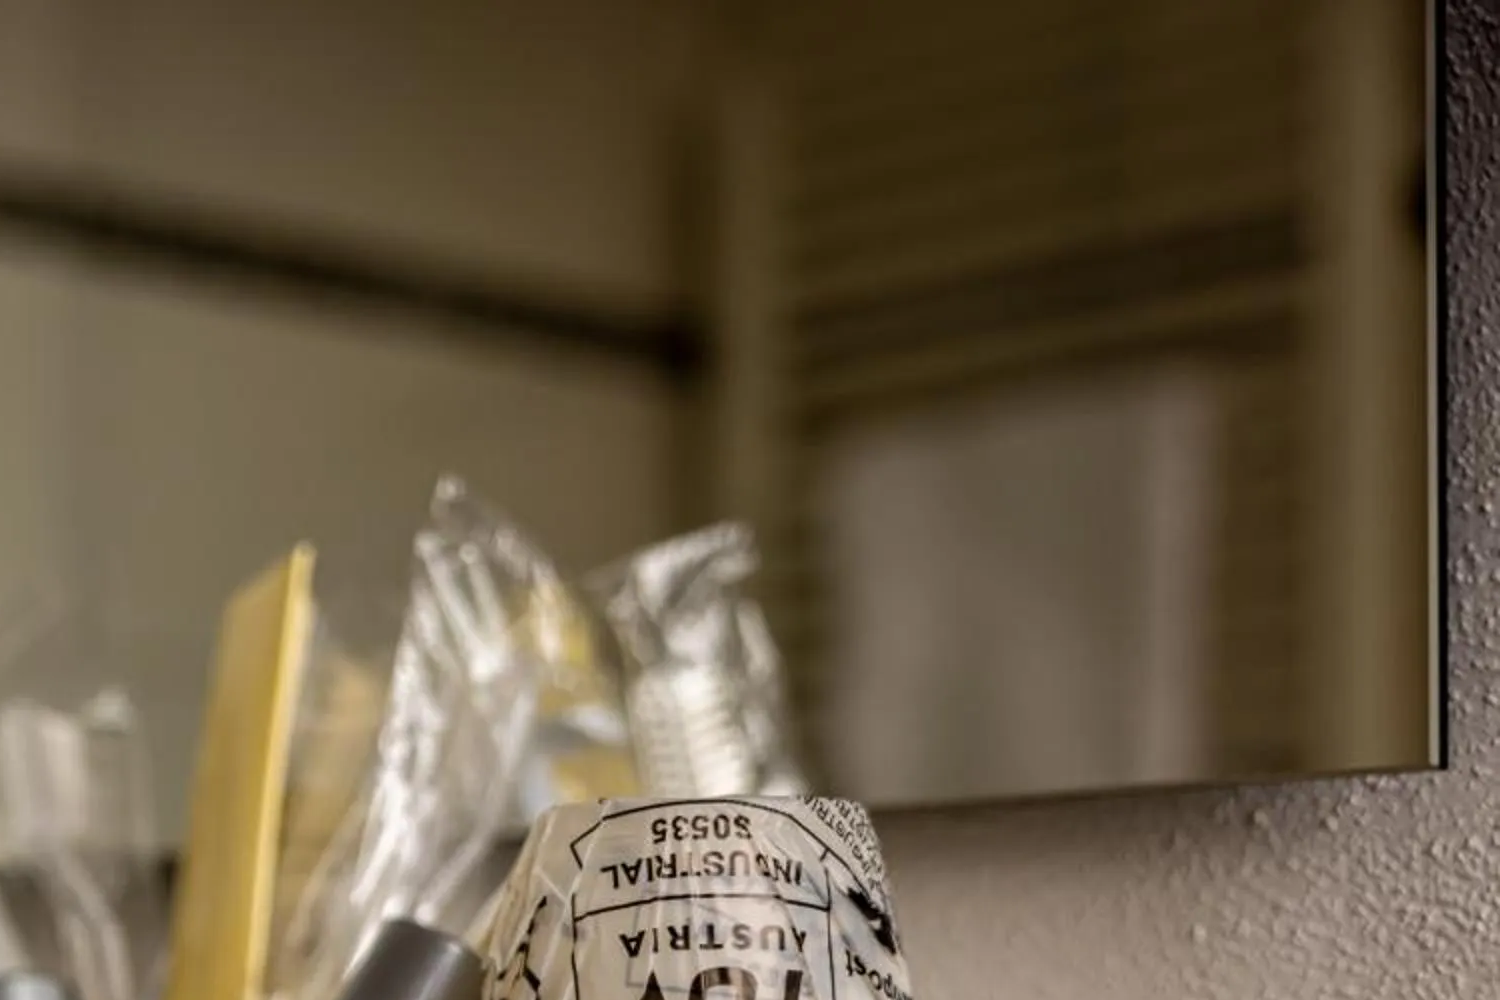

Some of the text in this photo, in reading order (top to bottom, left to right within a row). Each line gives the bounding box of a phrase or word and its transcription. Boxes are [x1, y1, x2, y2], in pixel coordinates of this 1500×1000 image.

[650, 814, 751, 844] S0535
[599, 851, 802, 889] INDUSTRIAL
[618, 924, 807, 958] AUSTRIA
